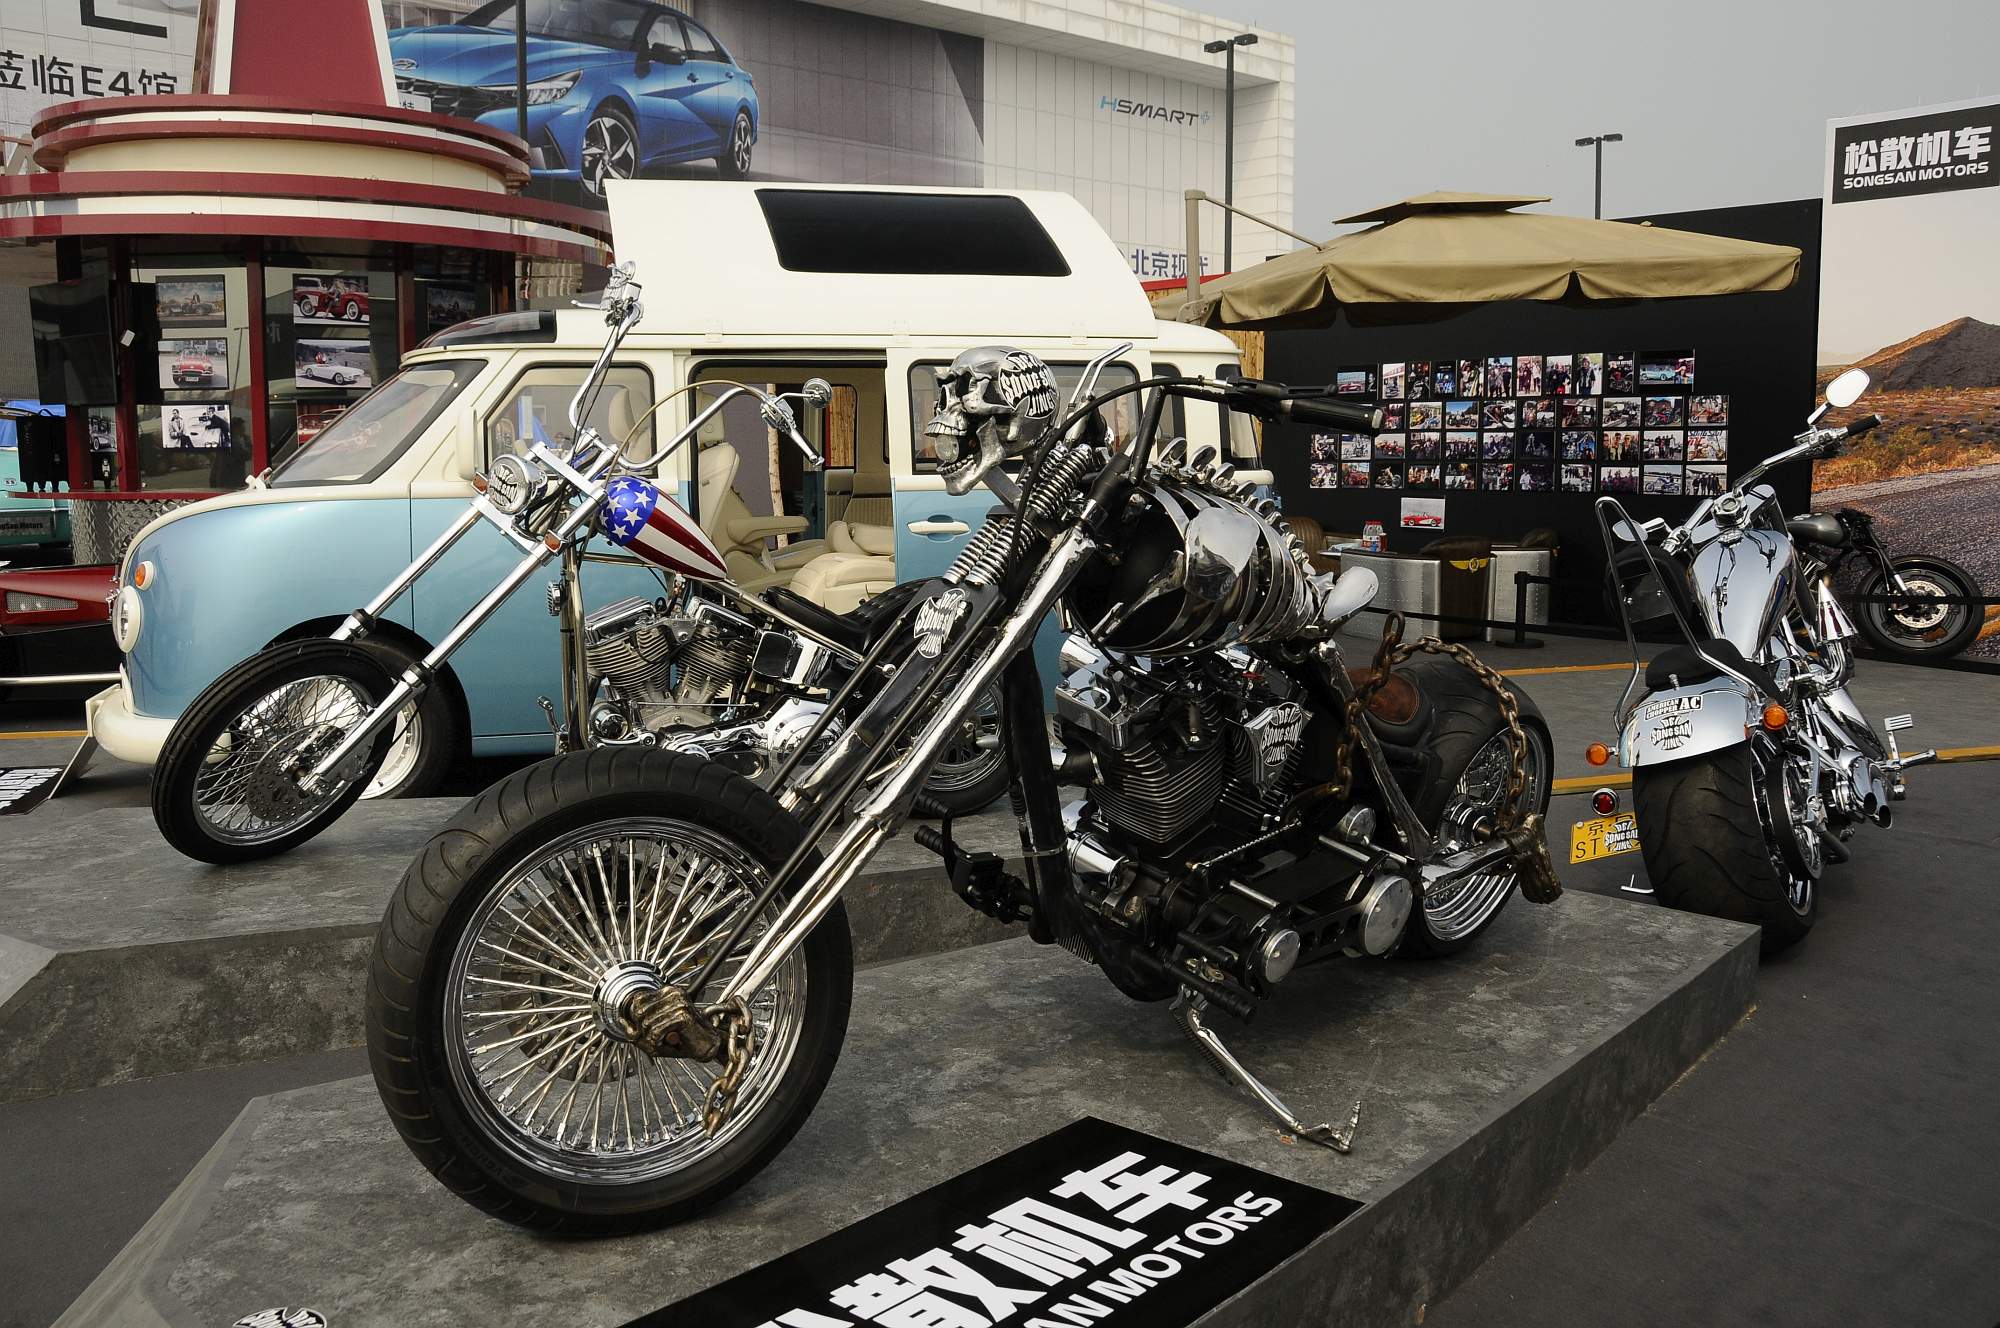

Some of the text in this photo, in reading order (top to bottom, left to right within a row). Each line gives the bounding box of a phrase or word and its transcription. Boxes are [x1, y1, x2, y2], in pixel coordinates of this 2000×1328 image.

[1844, 126, 1992, 175] 松散机车
[1843, 161, 1989, 189] SONGSAN MOTORS
[1646, 705, 1679, 719] CHOPPER
[1648, 699, 1680, 712] AMERICAN
[1680, 696, 1701, 710] AC
[1651, 722, 1692, 745] SONGSAN
[754, 1151, 1212, 1328] 散机车
[1103, 1191, 1283, 1303] MOTORS
